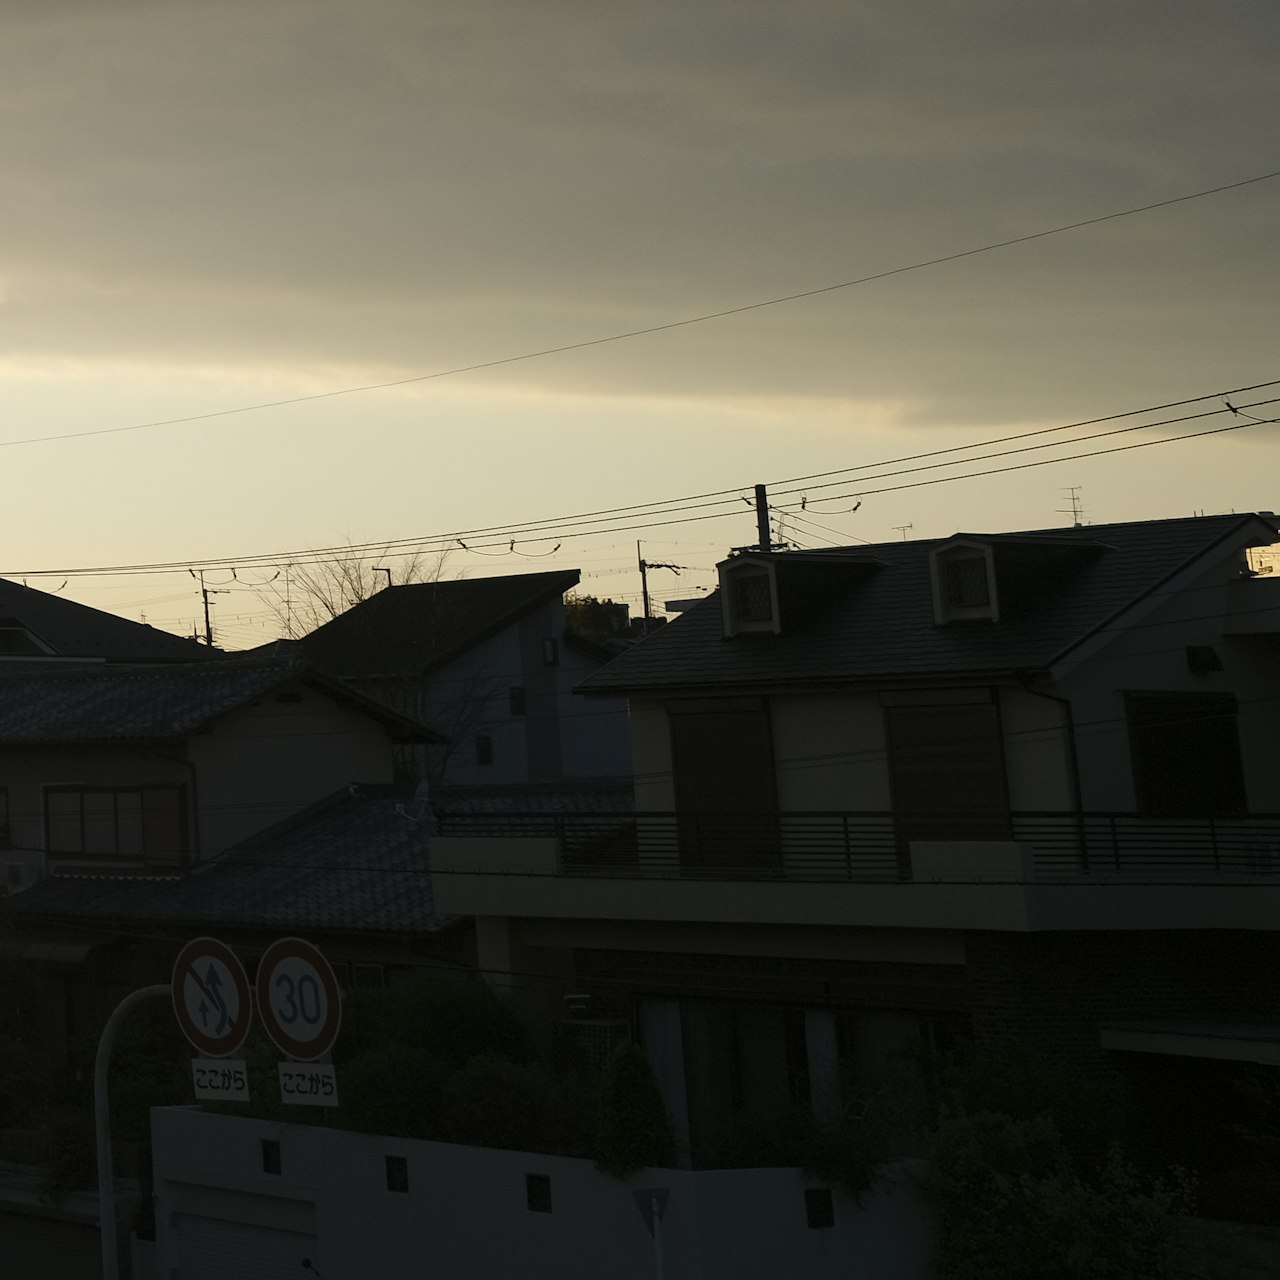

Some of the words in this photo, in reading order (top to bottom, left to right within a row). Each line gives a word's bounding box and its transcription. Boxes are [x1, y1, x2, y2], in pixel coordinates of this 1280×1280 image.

[276, 974, 321, 1024] 30
[196, 1069, 245, 1091] ここから
[282, 1073, 334, 1096] ここから
